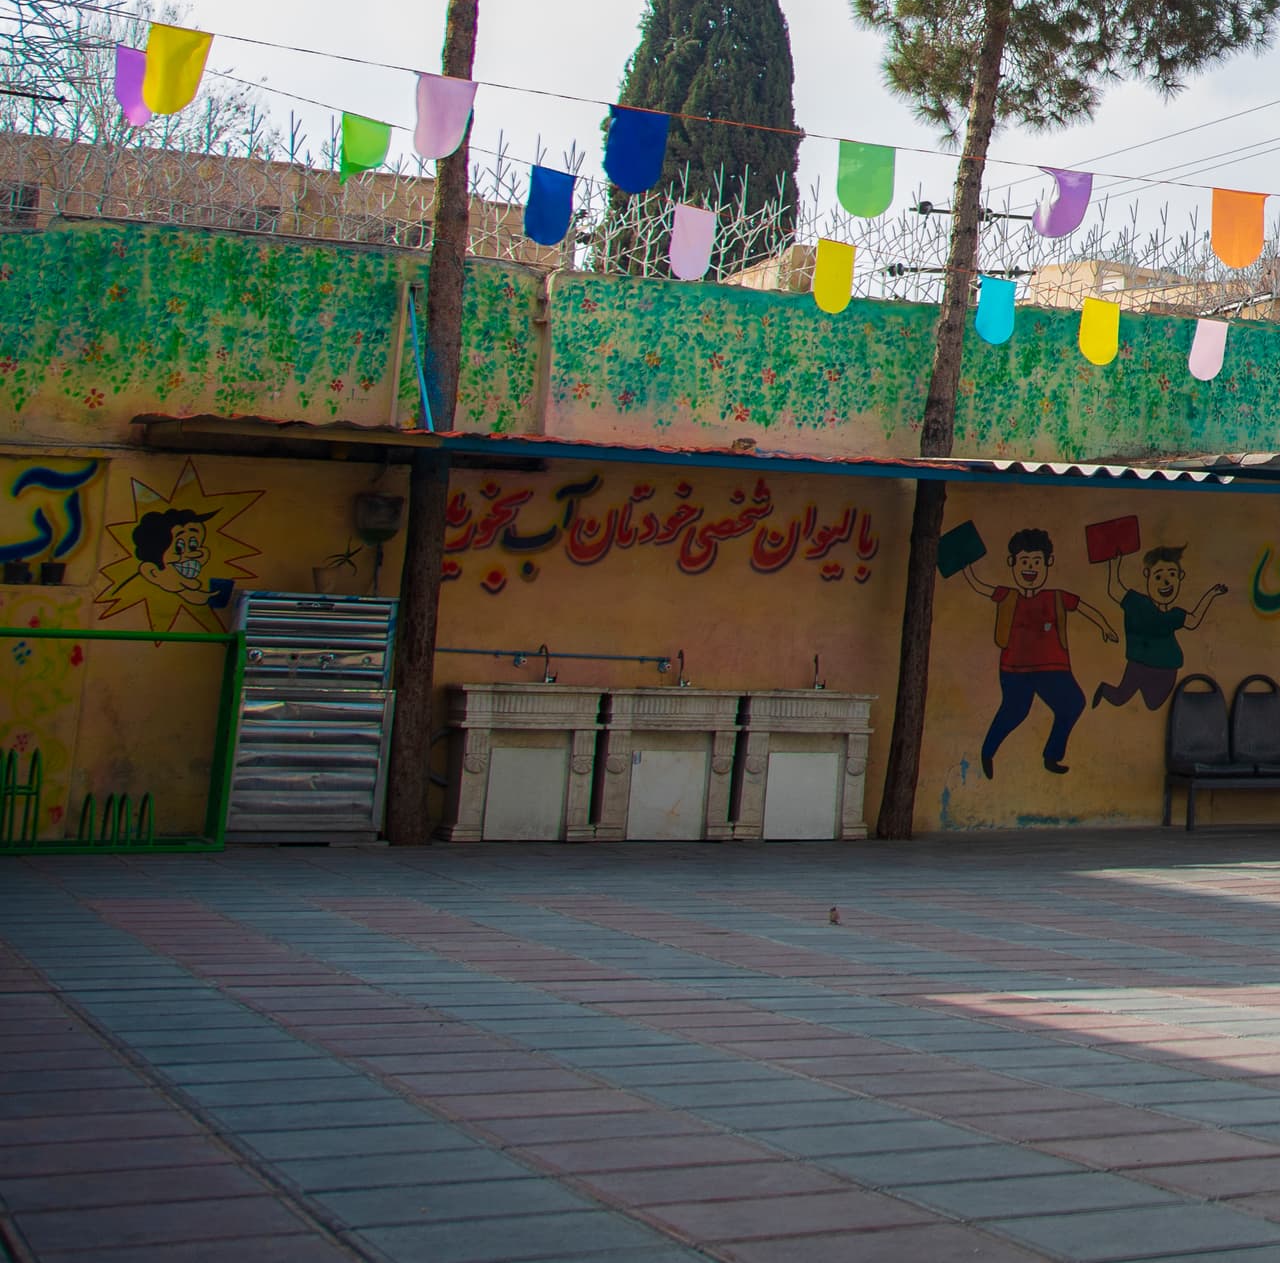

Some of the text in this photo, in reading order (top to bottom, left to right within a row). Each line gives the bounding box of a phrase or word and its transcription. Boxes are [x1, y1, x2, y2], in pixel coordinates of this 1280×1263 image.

[502, 475, 602, 581] آب
[566, 481, 704, 566] خودتان
[679, 479, 774, 574] شخصی
[752, 503, 851, 581] لیوان
[855, 510, 878, 582] با
